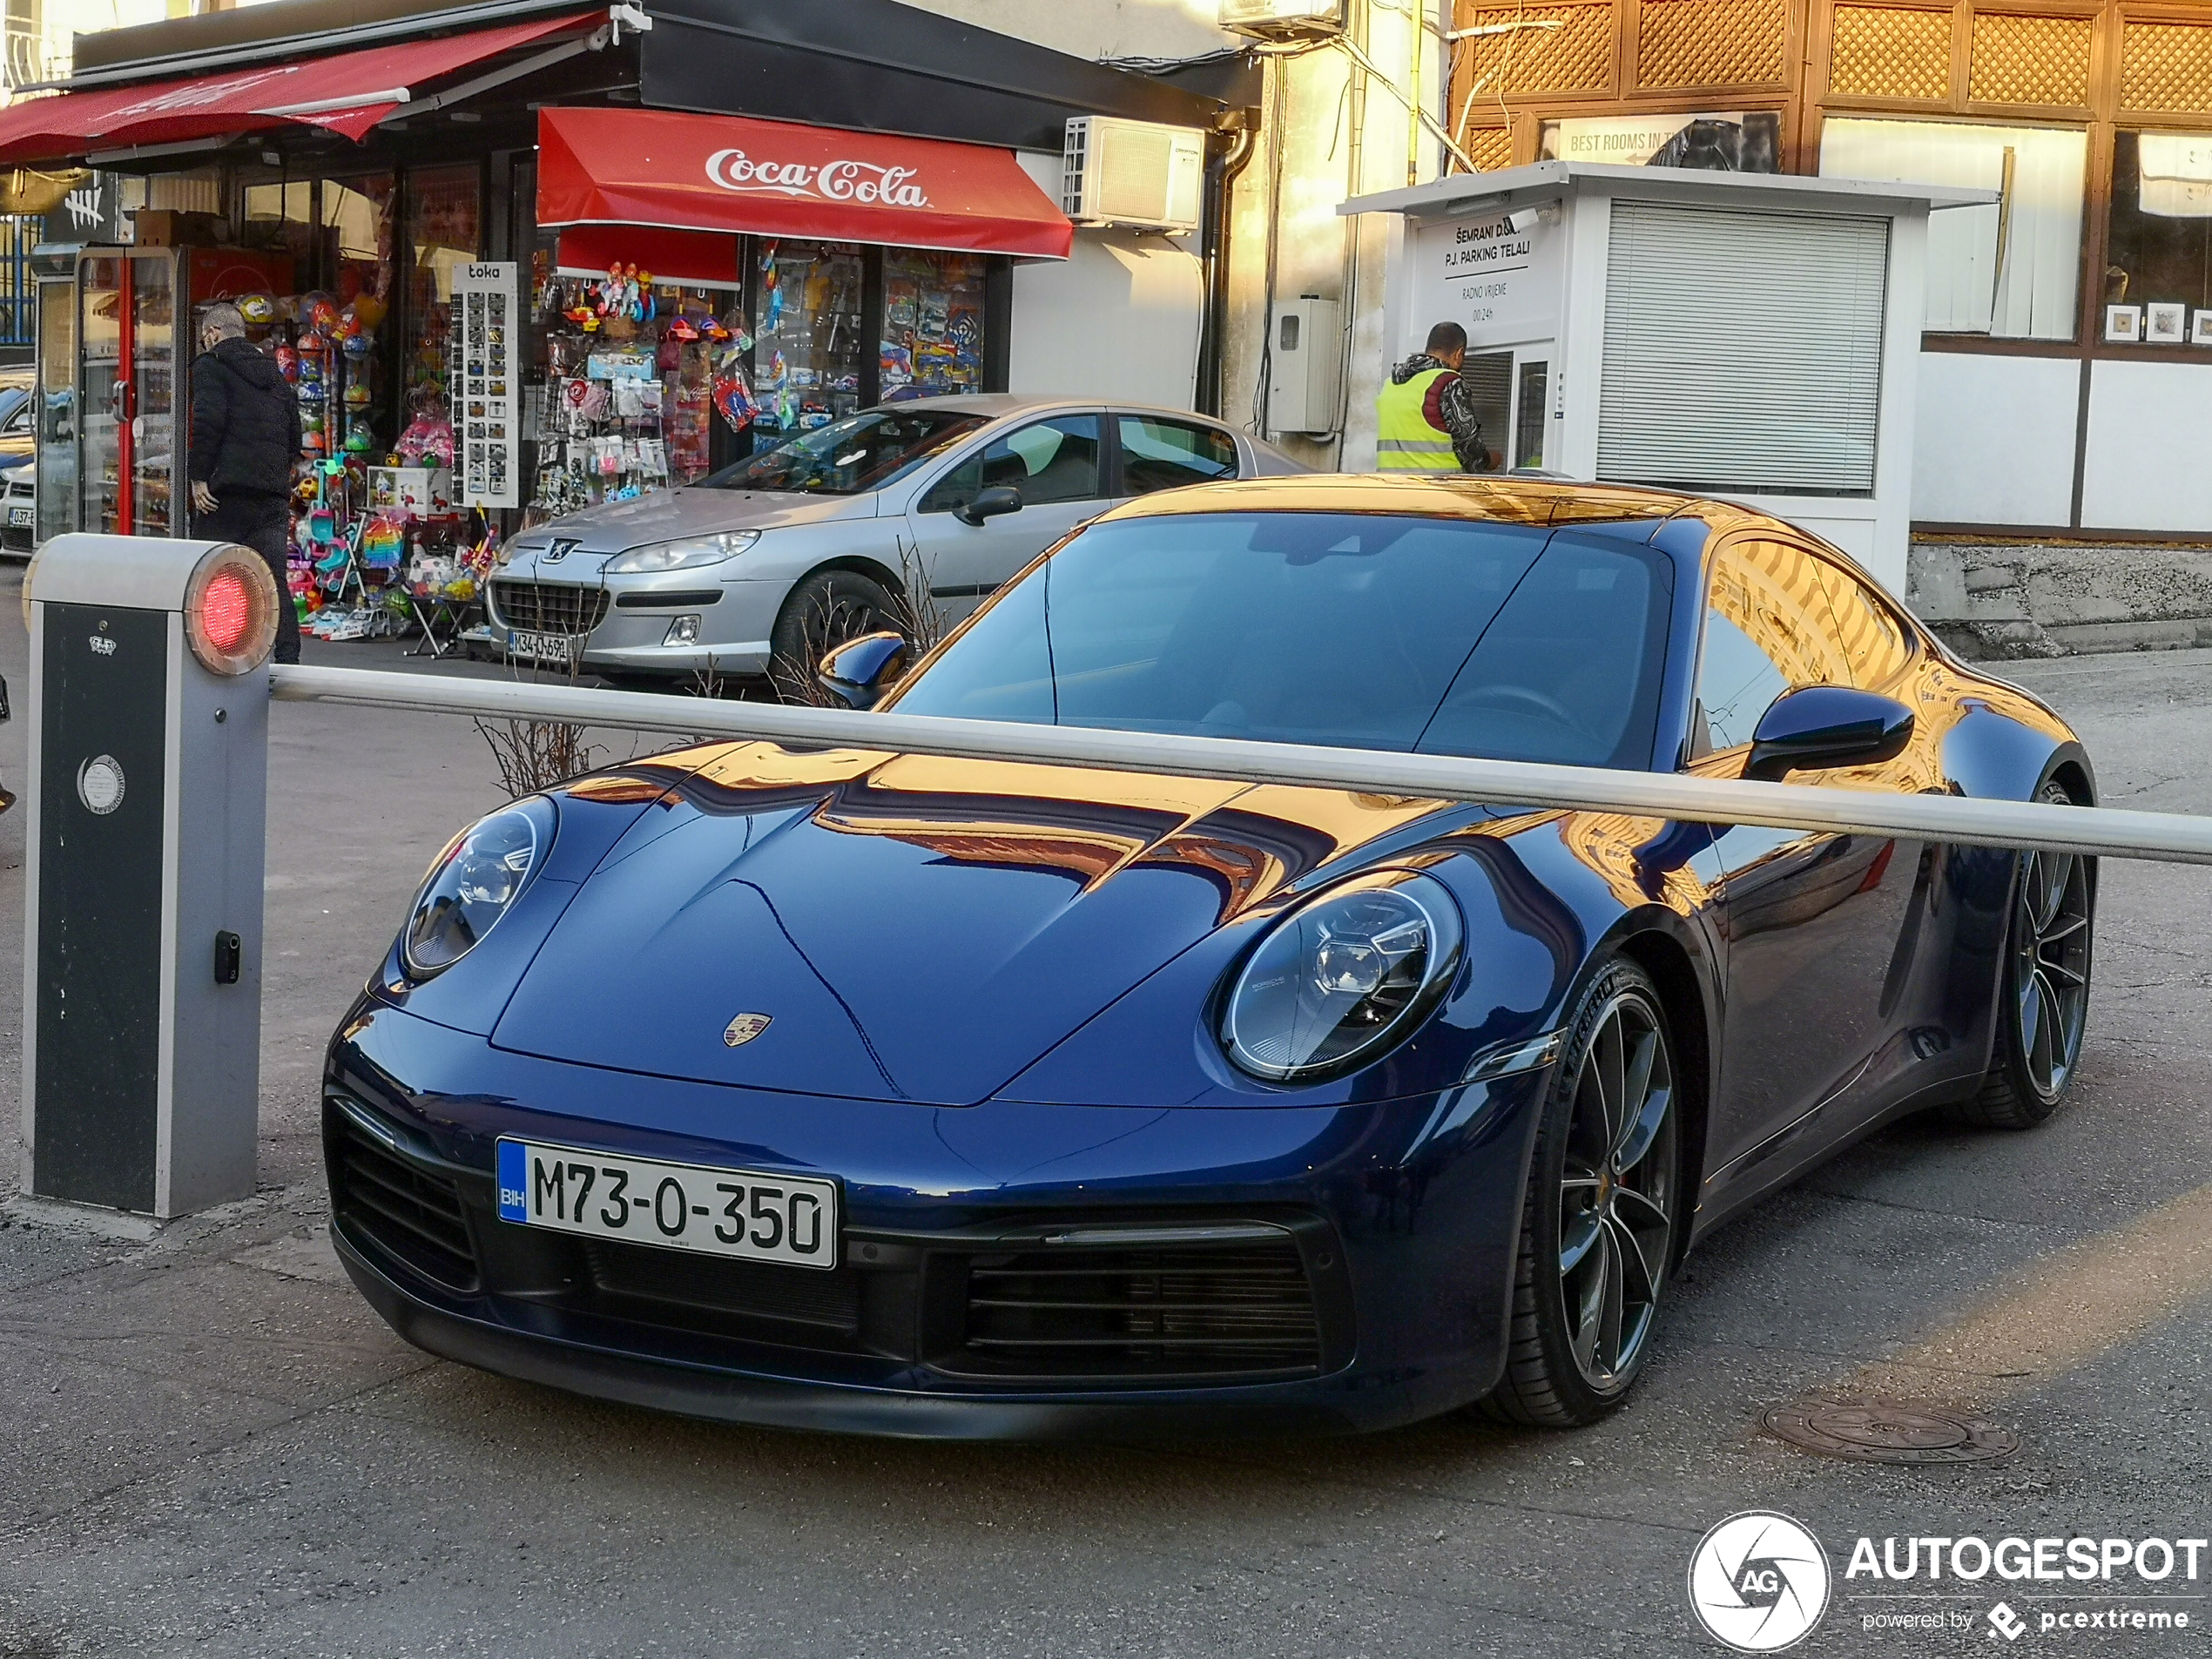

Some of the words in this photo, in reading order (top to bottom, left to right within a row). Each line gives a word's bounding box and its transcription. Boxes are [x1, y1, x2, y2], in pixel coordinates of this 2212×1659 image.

[1570, 134, 1601, 152] BEST
[1602, 132, 1646, 151] ROOMS
[1648, 132, 1661, 149] IN
[705, 149, 928, 207] Coca-Cola
[1456, 225, 1494, 244] ŠEMRANI
[1446, 253, 1459, 266] P.J.
[1460, 246, 1497, 265] PARKING
[1501, 240, 1531, 259] TELALI
[469, 264, 500, 279] toka
[1462, 285, 1483, 300] RADNO
[1484, 282, 1507, 299] VRIJEME
[500, 1186, 526, 1209] BIH
